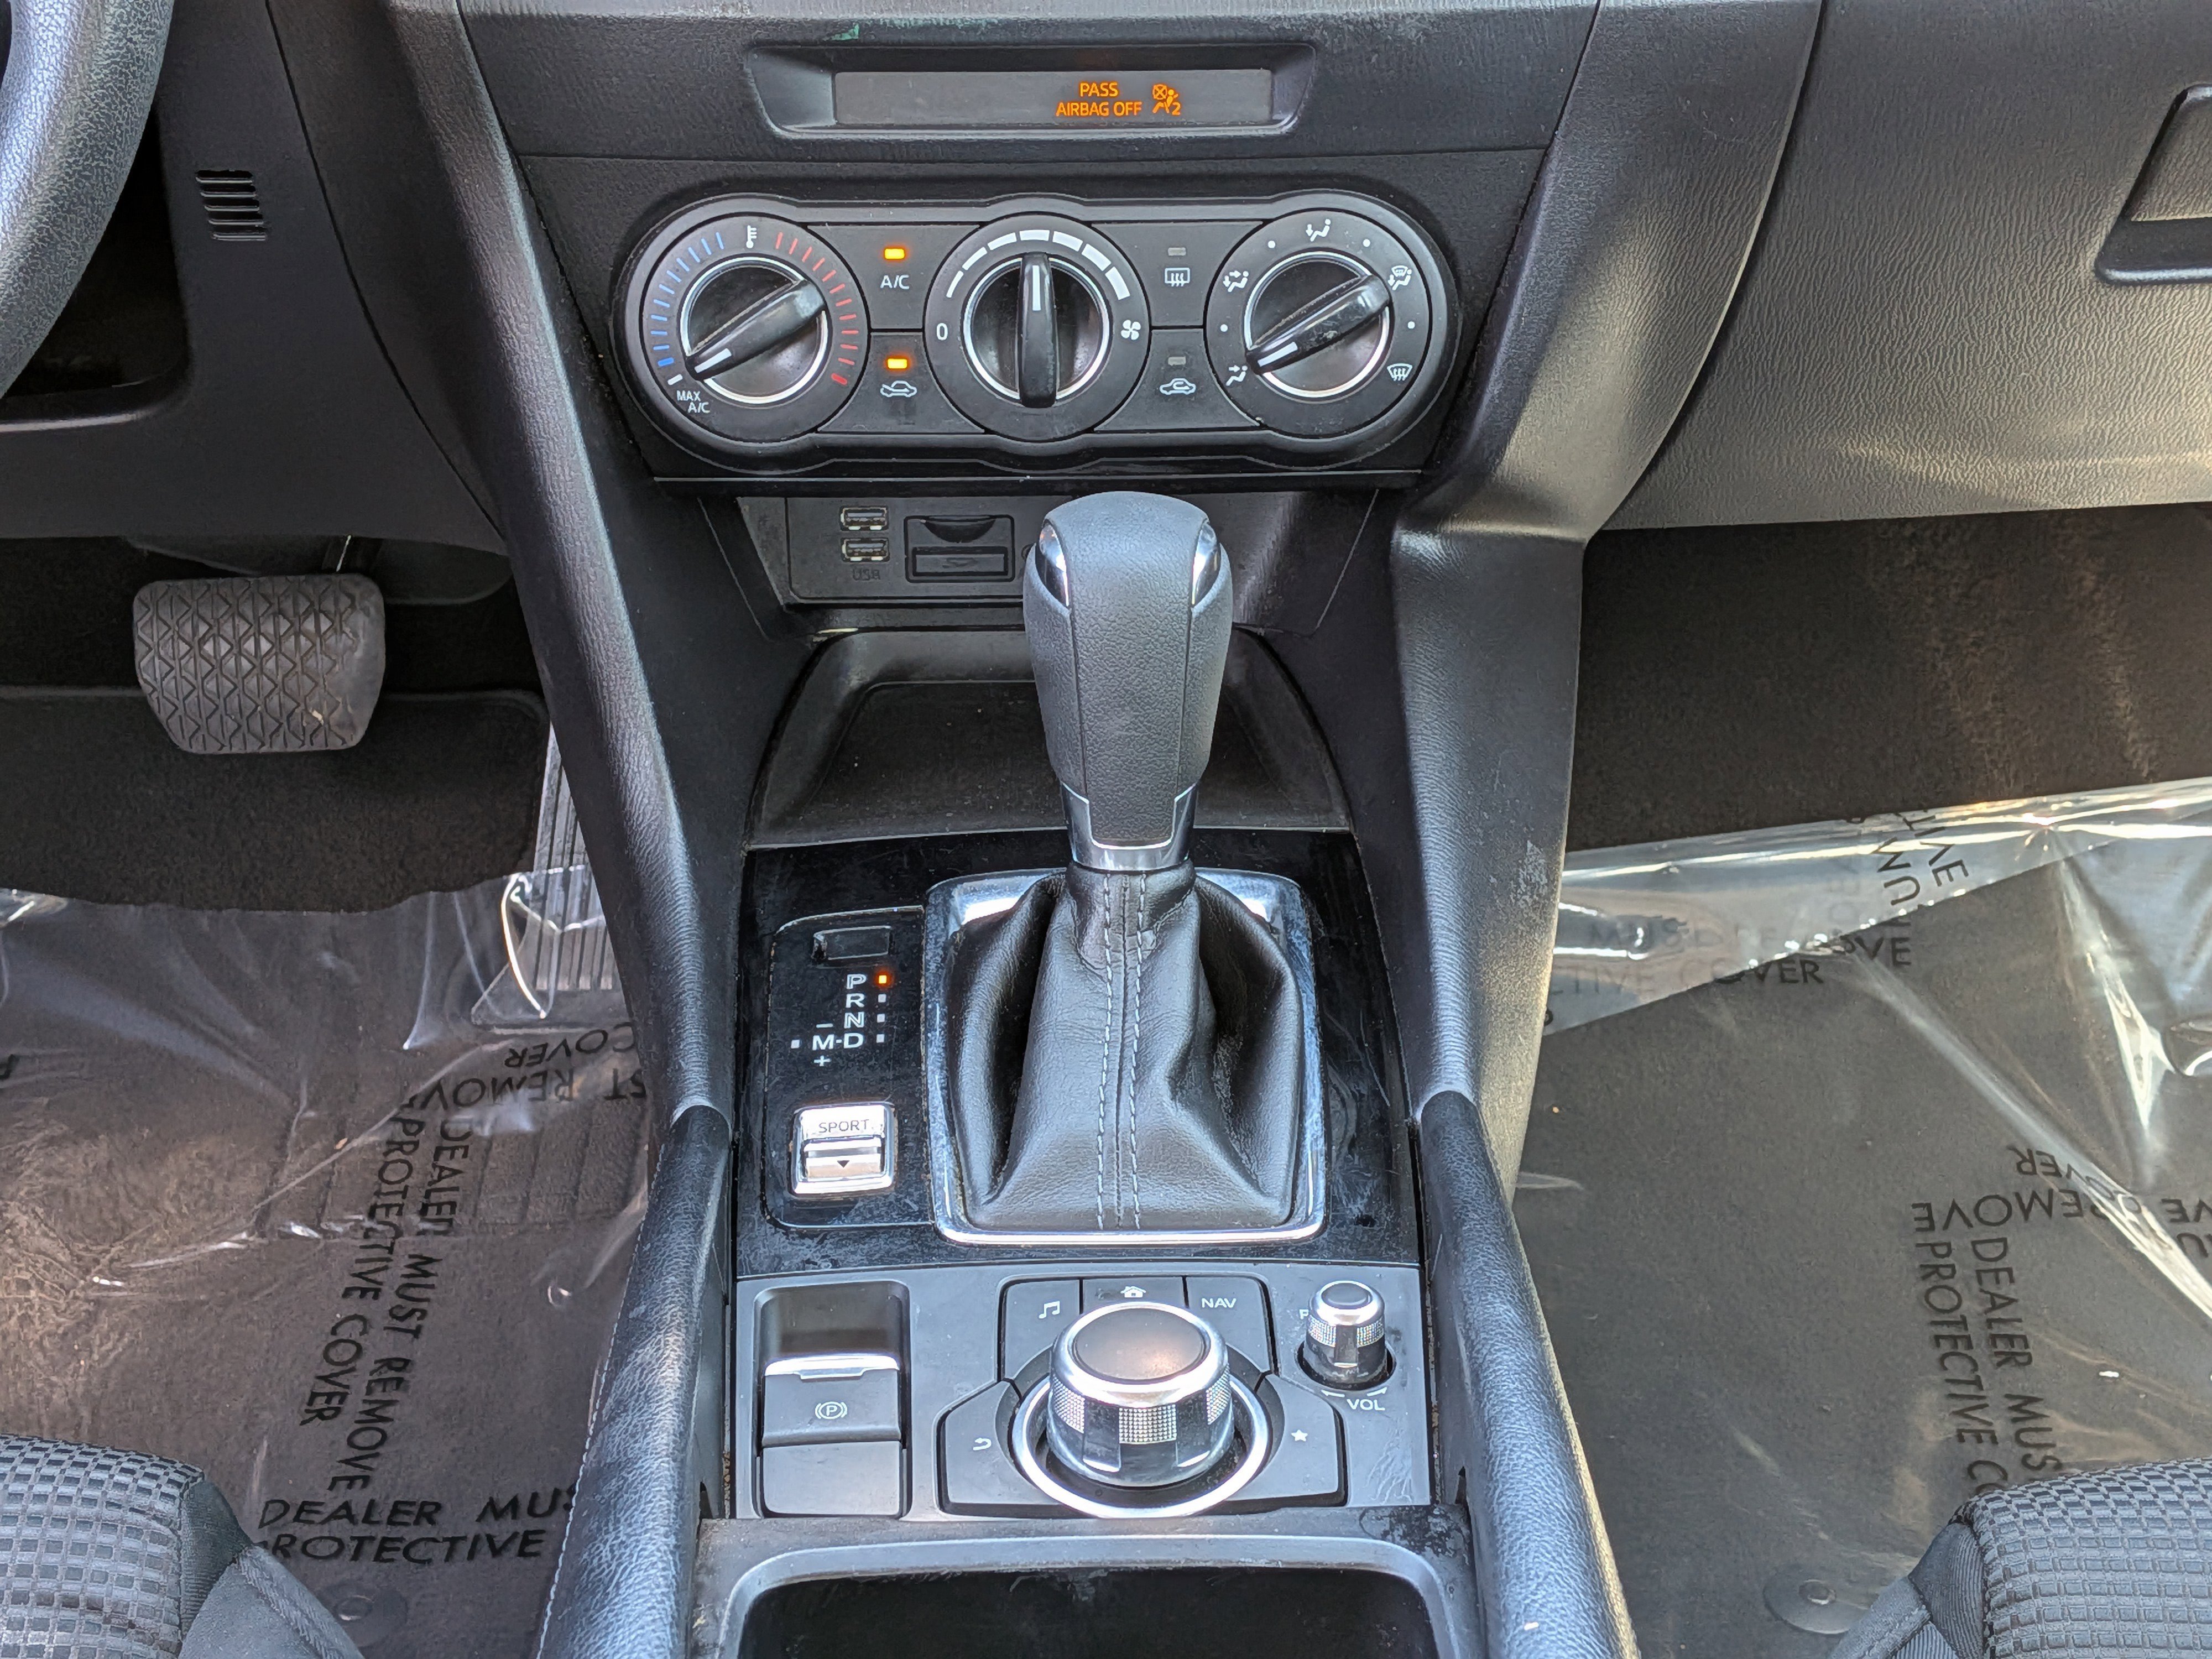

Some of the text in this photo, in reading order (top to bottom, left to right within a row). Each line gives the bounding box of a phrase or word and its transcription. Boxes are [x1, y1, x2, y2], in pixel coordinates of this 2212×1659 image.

[1079, 82, 1119, 97] PASS
[1055, 102, 1142, 117] AIRBAG OFF
[880, 275, 910, 290] A/C
[677, 390, 701, 401] MAX
[687, 401, 711, 414] A/C
[852, 568, 881, 581] USB
[846, 973, 867, 990] P
[846, 993, 865, 1008] R
[844, 1011, 865, 1029] N
[504, 1022, 635, 1068] COVER
[818, 1119, 870, 1133] SPORT
[299, 1115, 425, 1426] PROTECTIVE COVER
[383, 1253, 442, 1339] MUST
[1201, 1297, 1237, 1310] NAV
[1914, 1241, 1999, 1446] PROTECTIVE
[1970, 1237, 2063, 1472] DEALER MUS
[1347, 1399, 1386, 1411] VOL
[327, 1357, 413, 1491] REMOVE
[258, 1499, 442, 1529] DEALER
